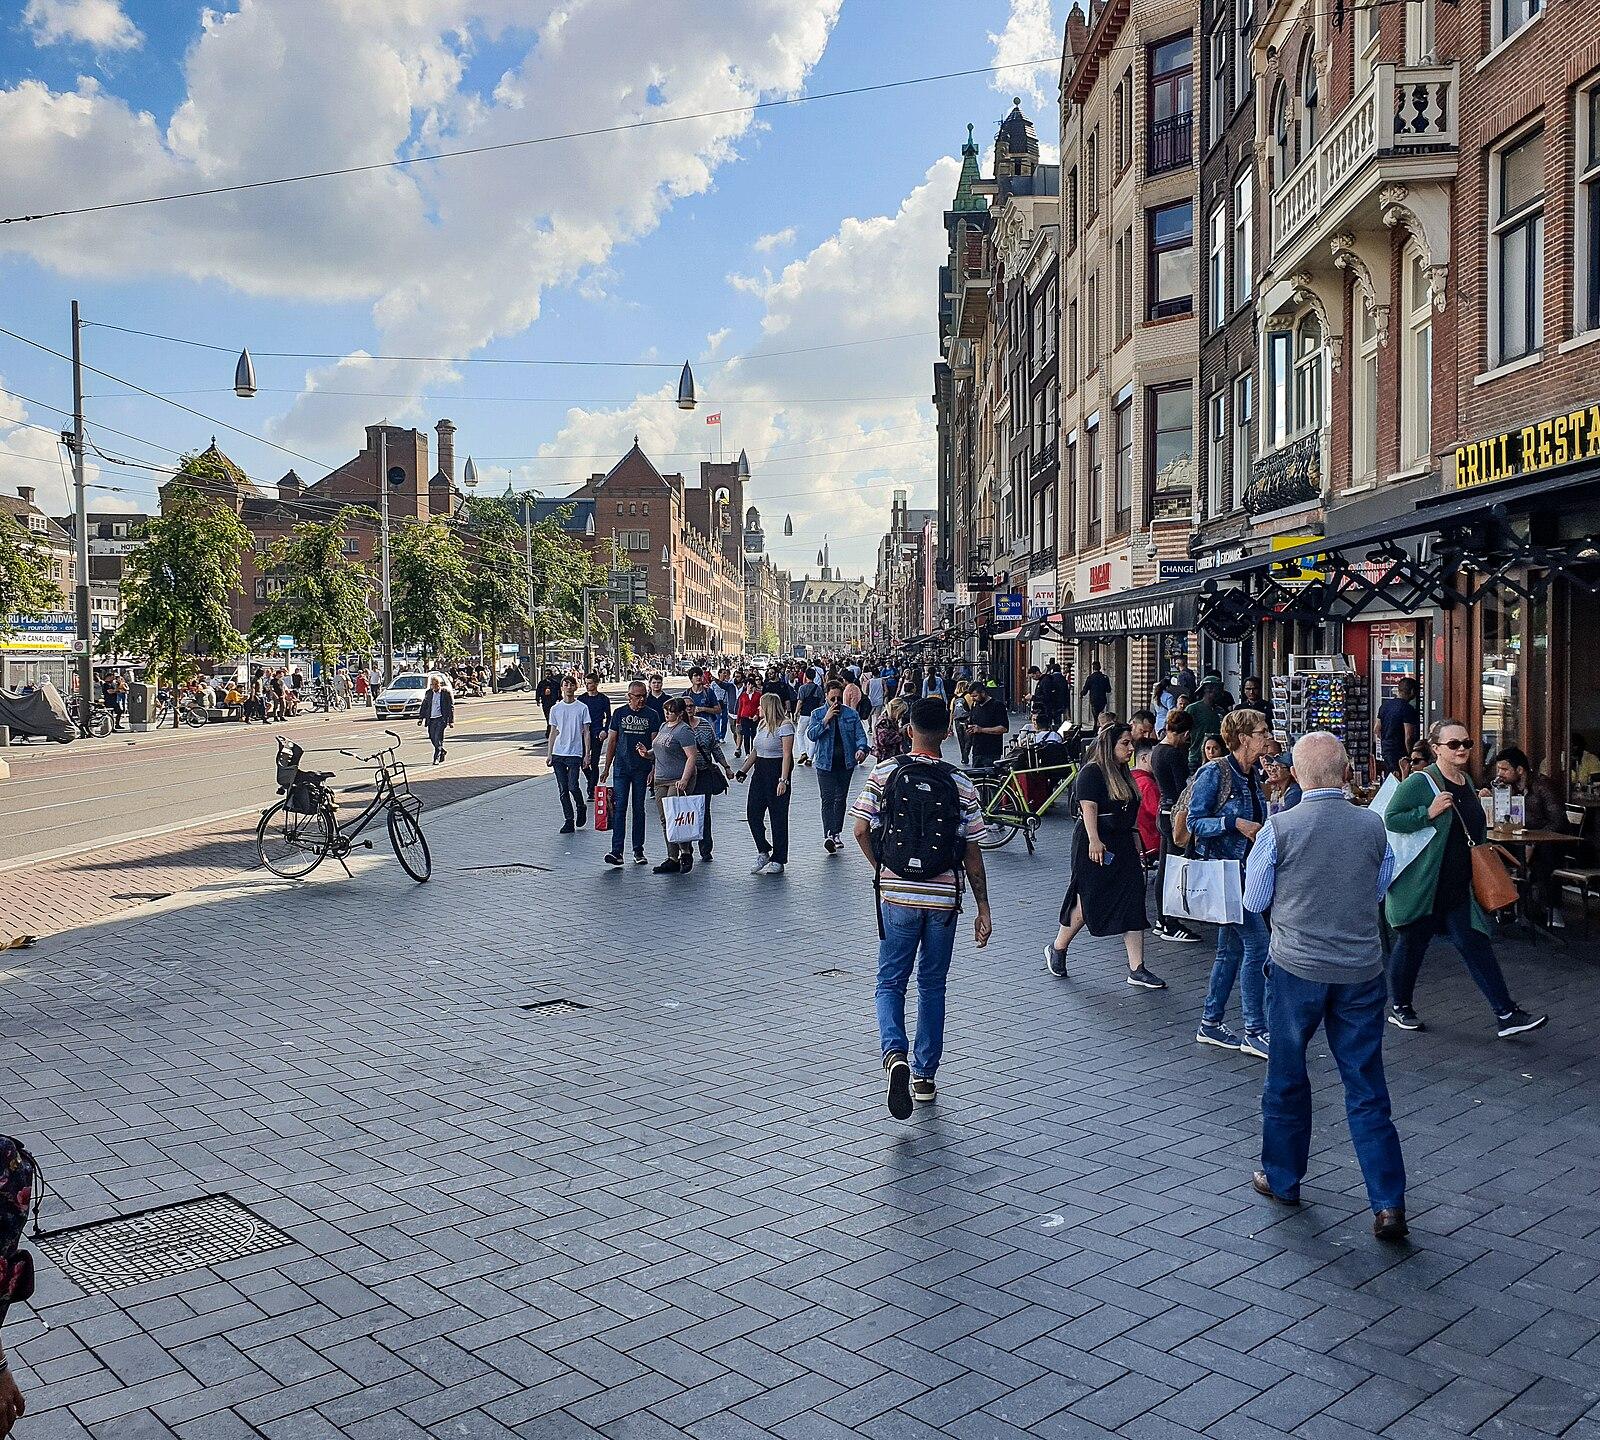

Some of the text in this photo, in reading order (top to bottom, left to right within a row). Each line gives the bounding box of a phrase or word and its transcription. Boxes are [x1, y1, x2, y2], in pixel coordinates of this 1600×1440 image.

[1455, 405, 1600, 490] GRILL RESTA
[1161, 565, 1194, 573] CHANGE
[1074, 612, 1104, 633] BRASSERIE
[1109, 611, 1127, 631] GRILL
[1127, 603, 1175, 629] RESTAURANT
[46, 635, 63, 643] CRUISE
[675, 811, 695, 827] H&M
